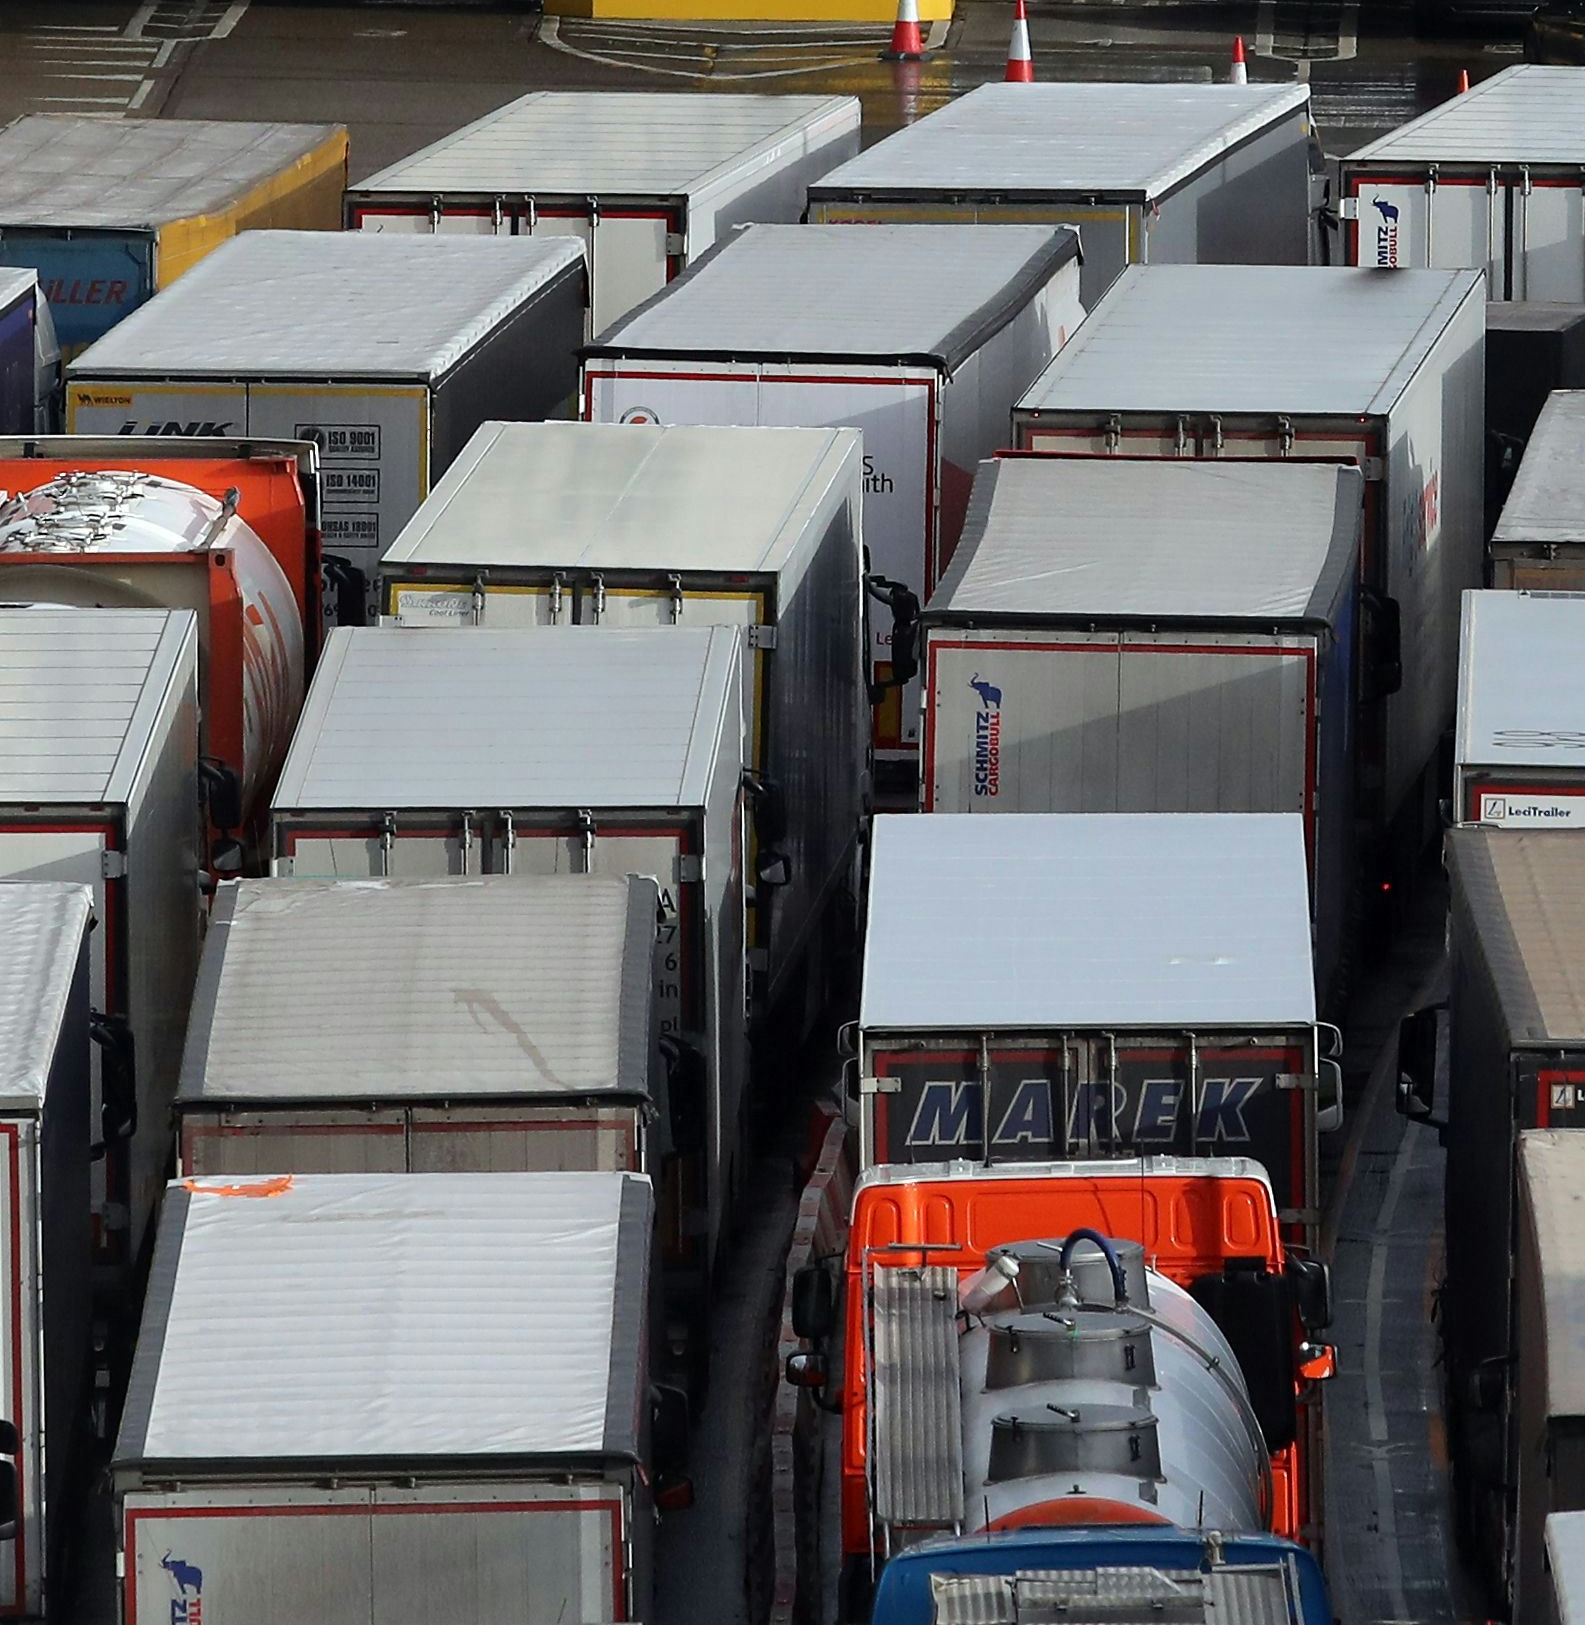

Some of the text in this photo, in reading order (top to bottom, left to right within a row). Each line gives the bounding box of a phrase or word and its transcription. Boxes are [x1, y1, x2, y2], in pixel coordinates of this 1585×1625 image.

[1377, 226, 1389, 269] MITZ
[328, 431, 375, 446] ISO 9001
[326, 475, 376, 488] ISO 14001
[975, 711, 990, 796] SCHMITZ
[989, 712, 1001, 796] CARGOBULL
[1508, 806, 1571, 817] LeciTrailer
[905, 1078, 1264, 1146] MAREK
